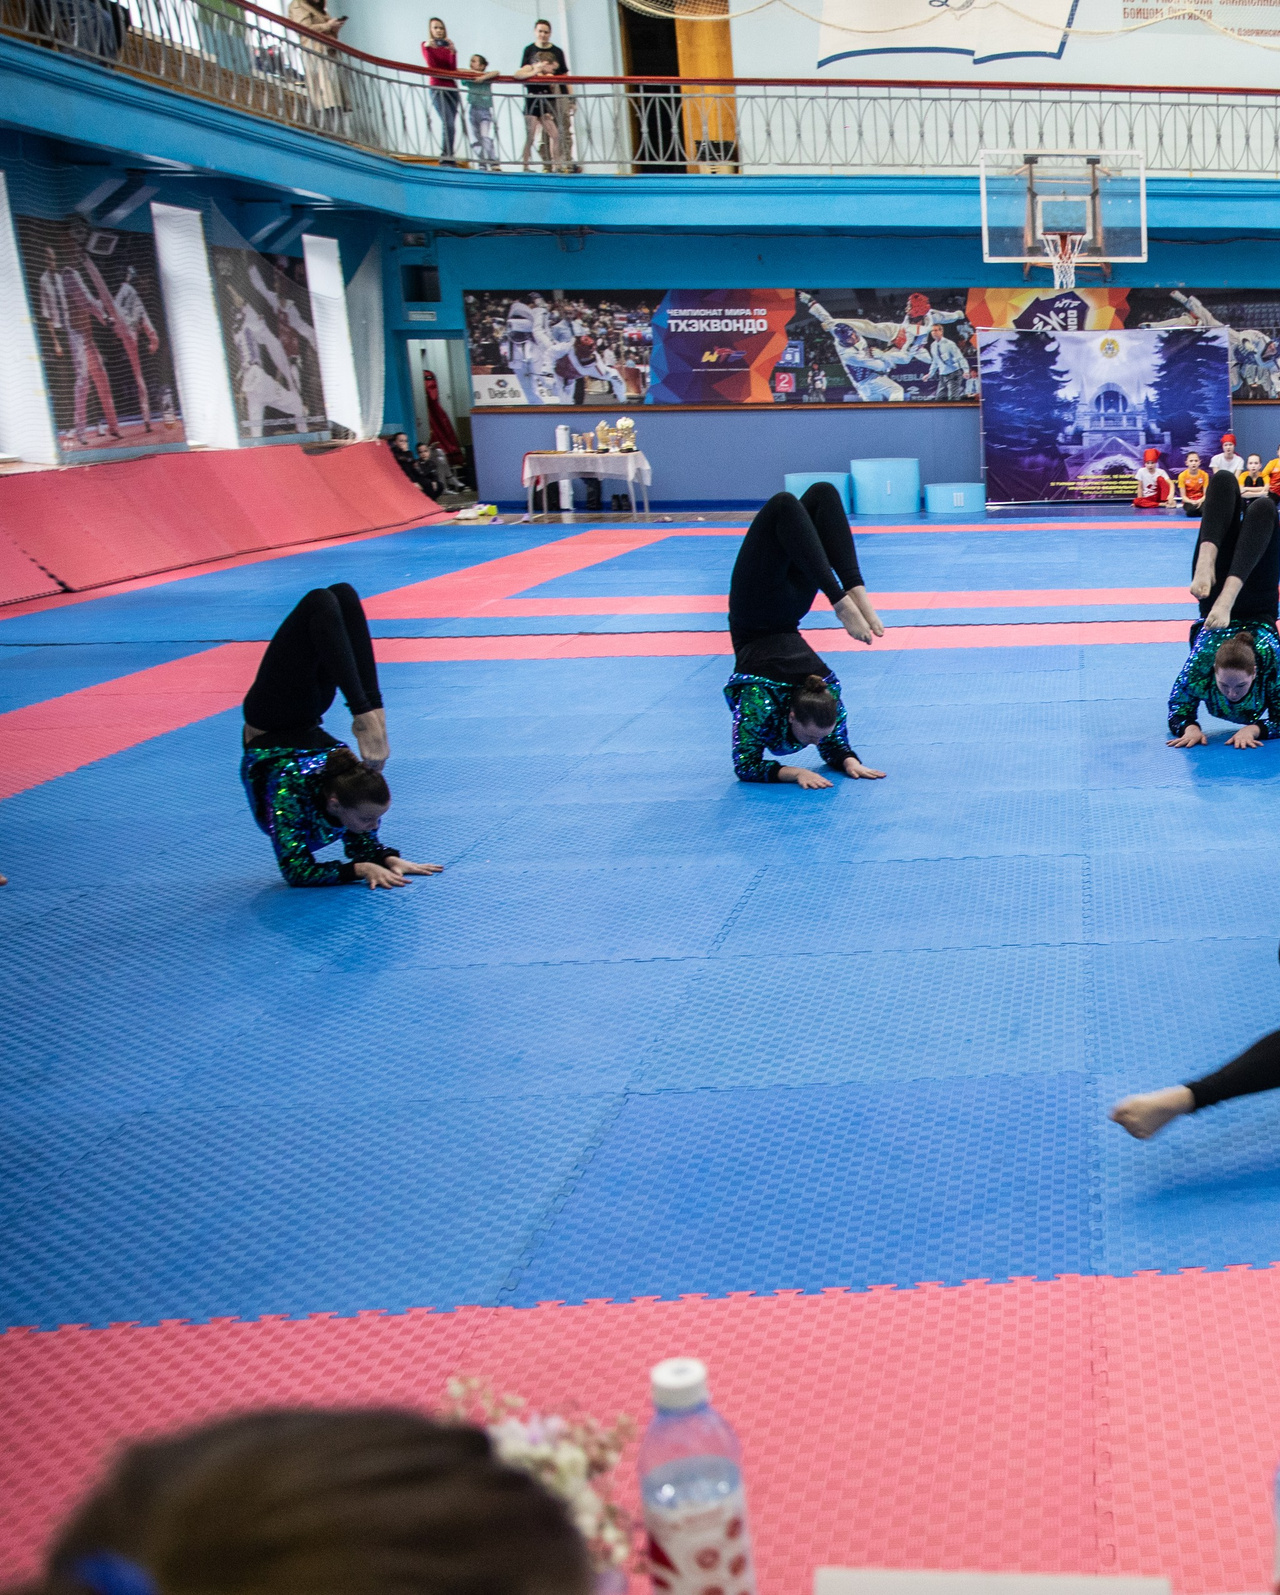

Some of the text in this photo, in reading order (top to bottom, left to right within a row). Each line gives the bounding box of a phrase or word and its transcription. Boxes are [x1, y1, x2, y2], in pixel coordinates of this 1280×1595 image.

[753, 308, 767, 316] ПО
[667, 319, 768, 334] ТХЭКВОНДО
[779, 374, 790, 387] 2
